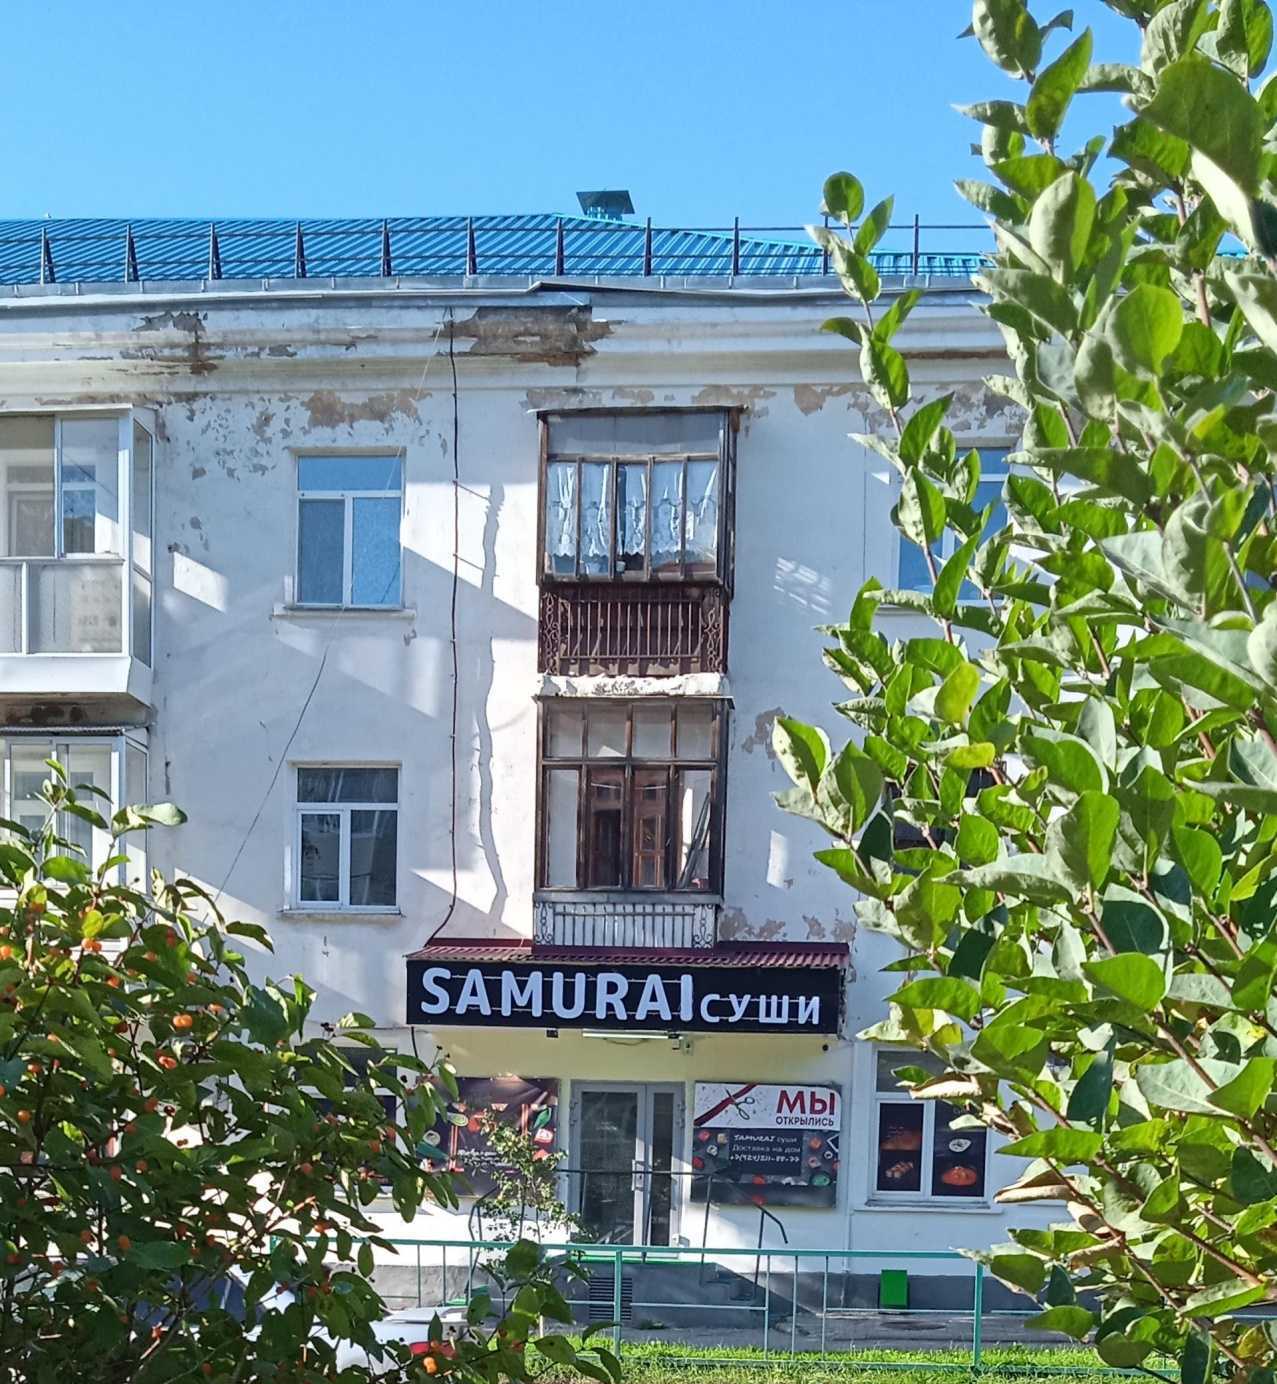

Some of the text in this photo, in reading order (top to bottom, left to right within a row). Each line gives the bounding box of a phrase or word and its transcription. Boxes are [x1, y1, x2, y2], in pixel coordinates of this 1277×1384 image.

[420, 967, 694, 1022] SAMURAI
[776, 1090, 835, 1115] МЫ
[775, 1116, 834, 1127] ОТКРЫЛИСЬ
